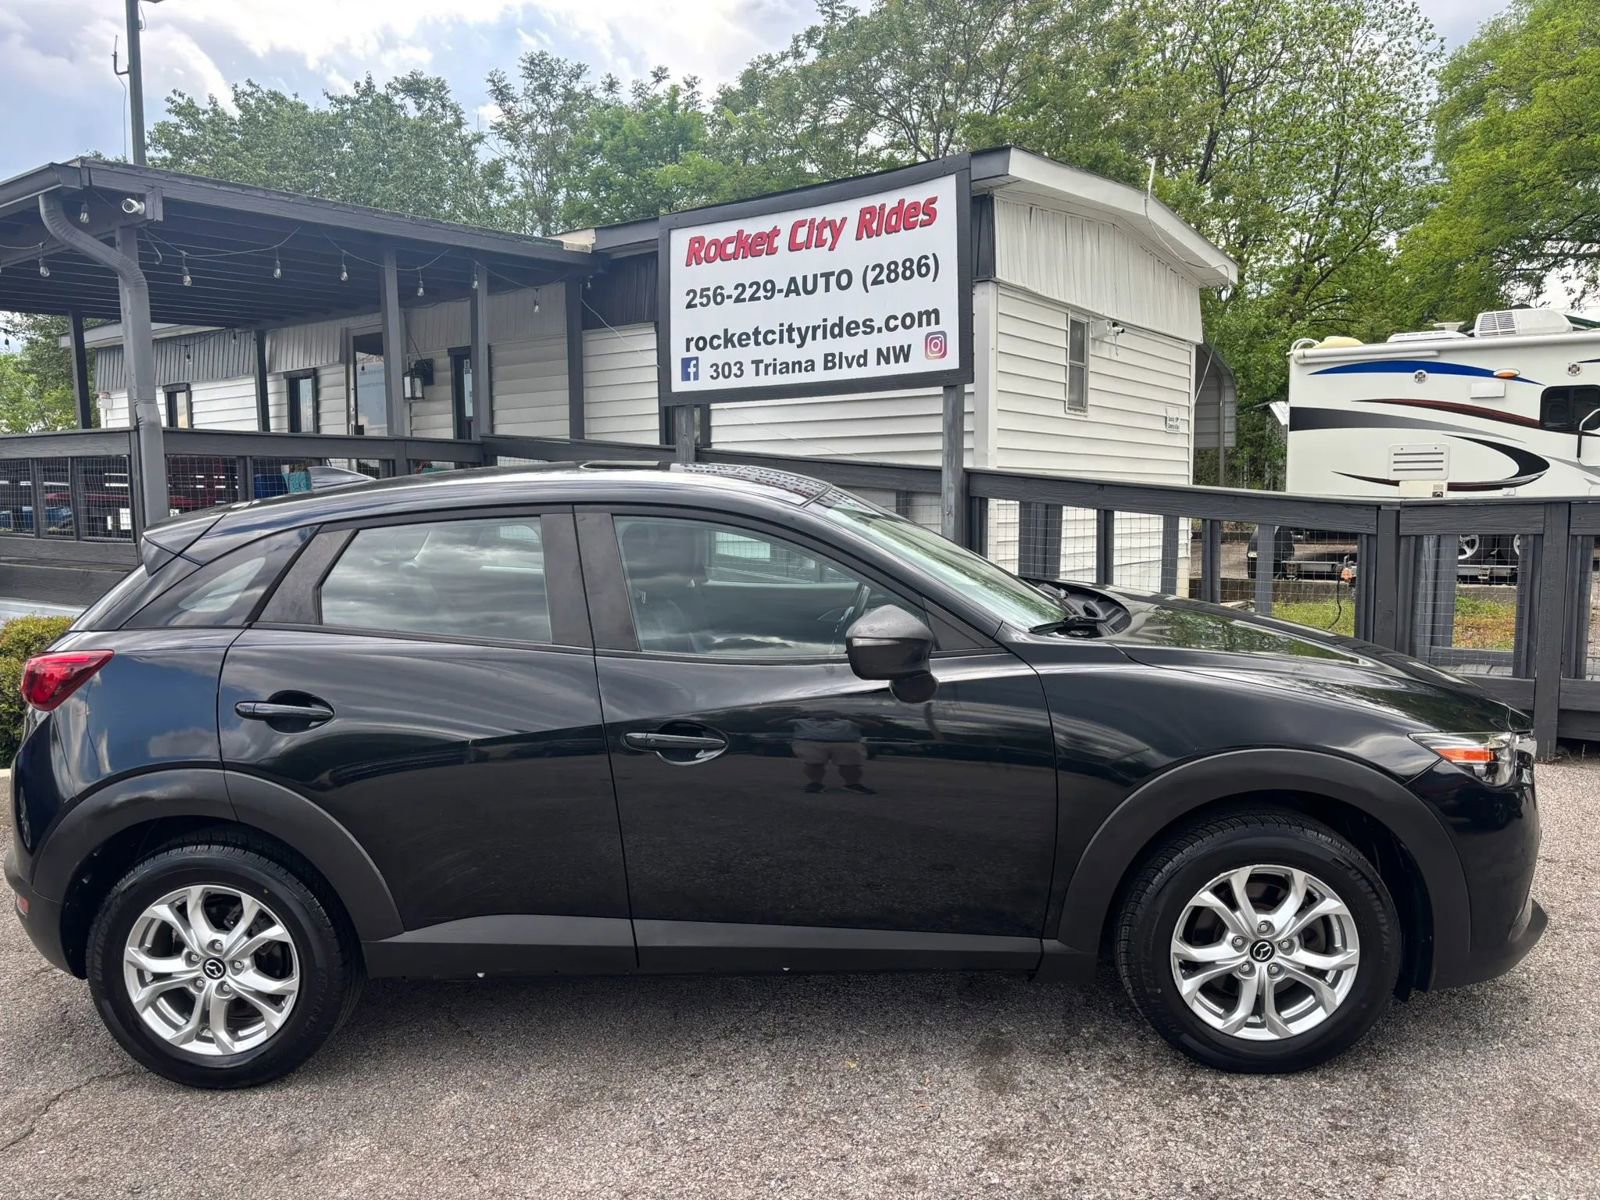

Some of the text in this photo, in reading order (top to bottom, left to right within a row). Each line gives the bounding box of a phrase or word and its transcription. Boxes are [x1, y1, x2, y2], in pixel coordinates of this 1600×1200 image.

[685, 197, 938, 267] Rocket City Rides
[685, 253, 940, 309] 256-229-AUTO (2886)
[685, 308, 940, 353] rocketcityrides.com
[709, 344, 912, 380] 303 Triana Blvd NW
